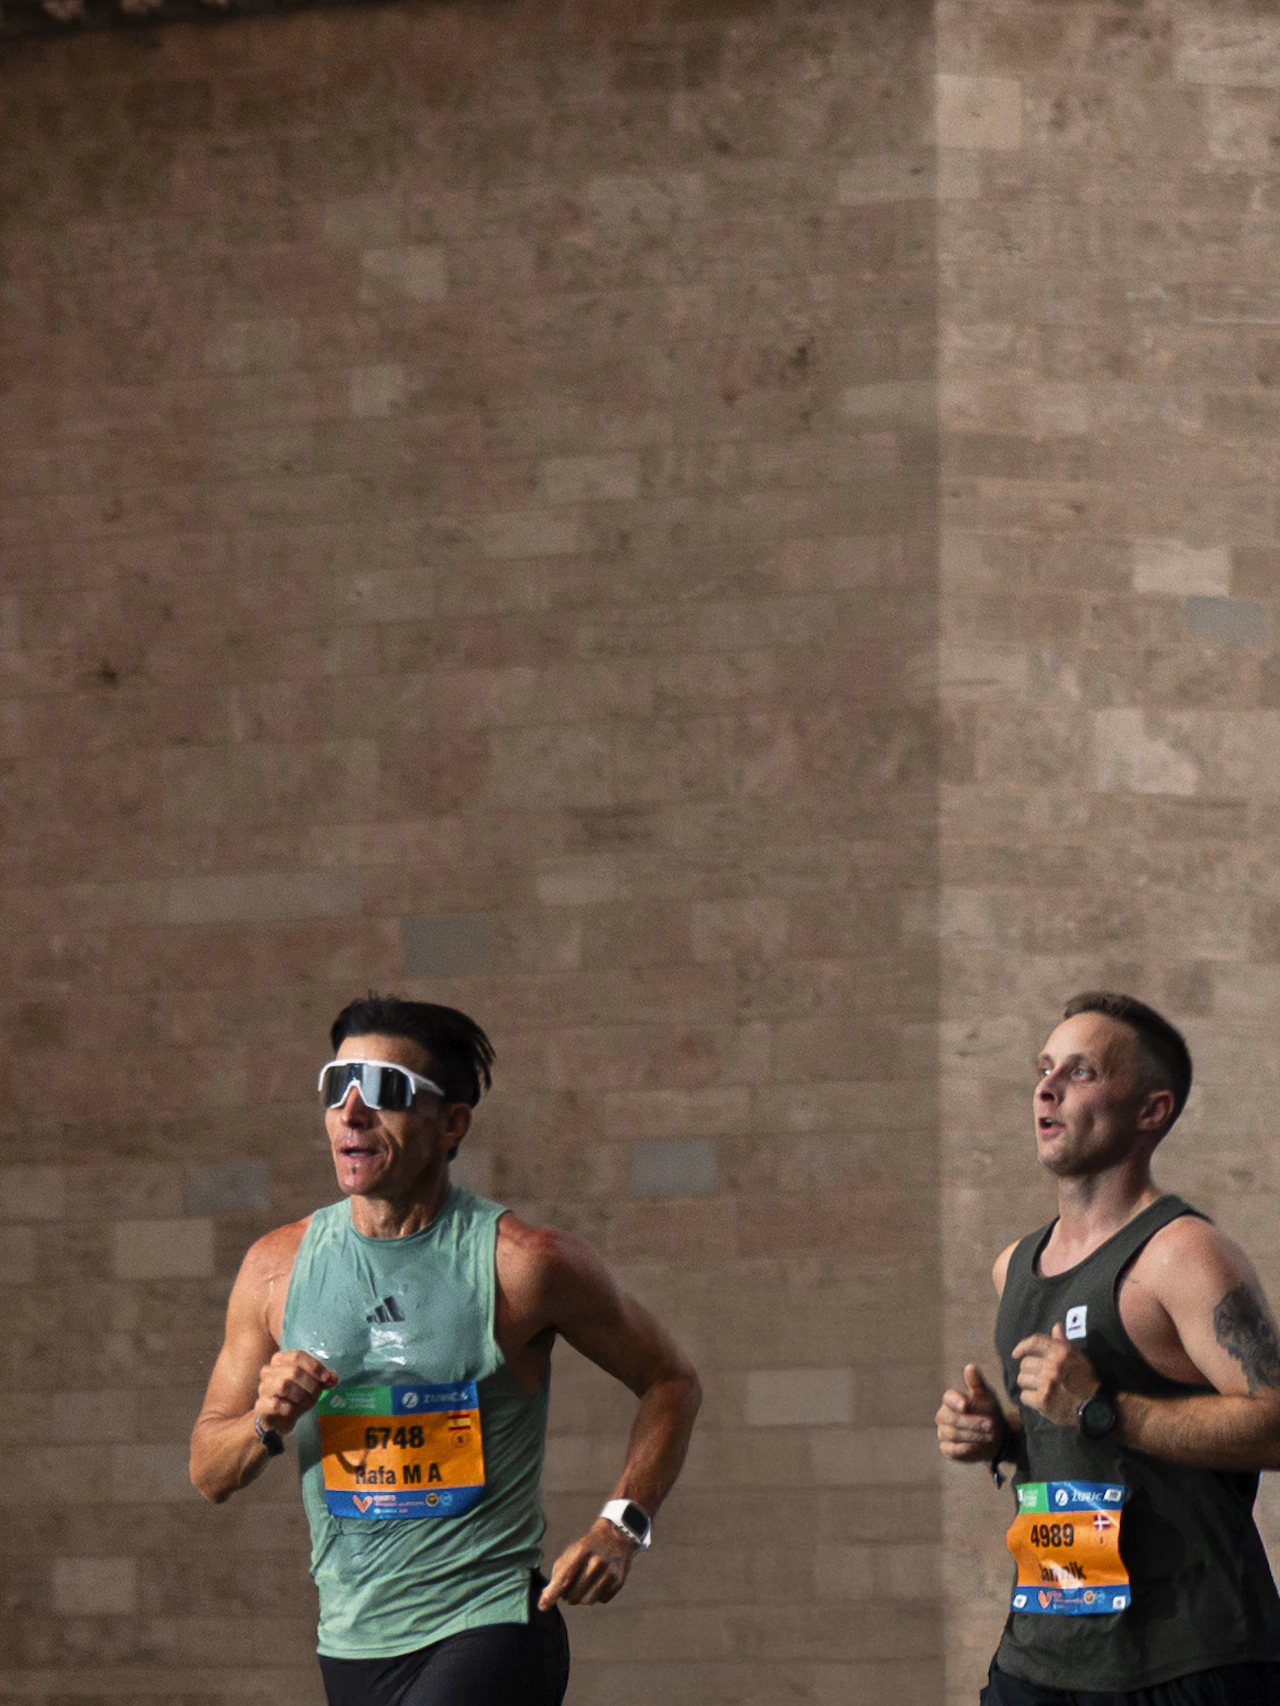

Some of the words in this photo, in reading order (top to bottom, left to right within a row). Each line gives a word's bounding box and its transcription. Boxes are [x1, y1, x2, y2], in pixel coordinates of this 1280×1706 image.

[365, 1426, 424, 1449] 6748
[355, 1465, 396, 1484] Rafa
[403, 1464, 422, 1483] M
[427, 1463, 443, 1482] A
[1030, 1523, 1074, 1547] 4989
